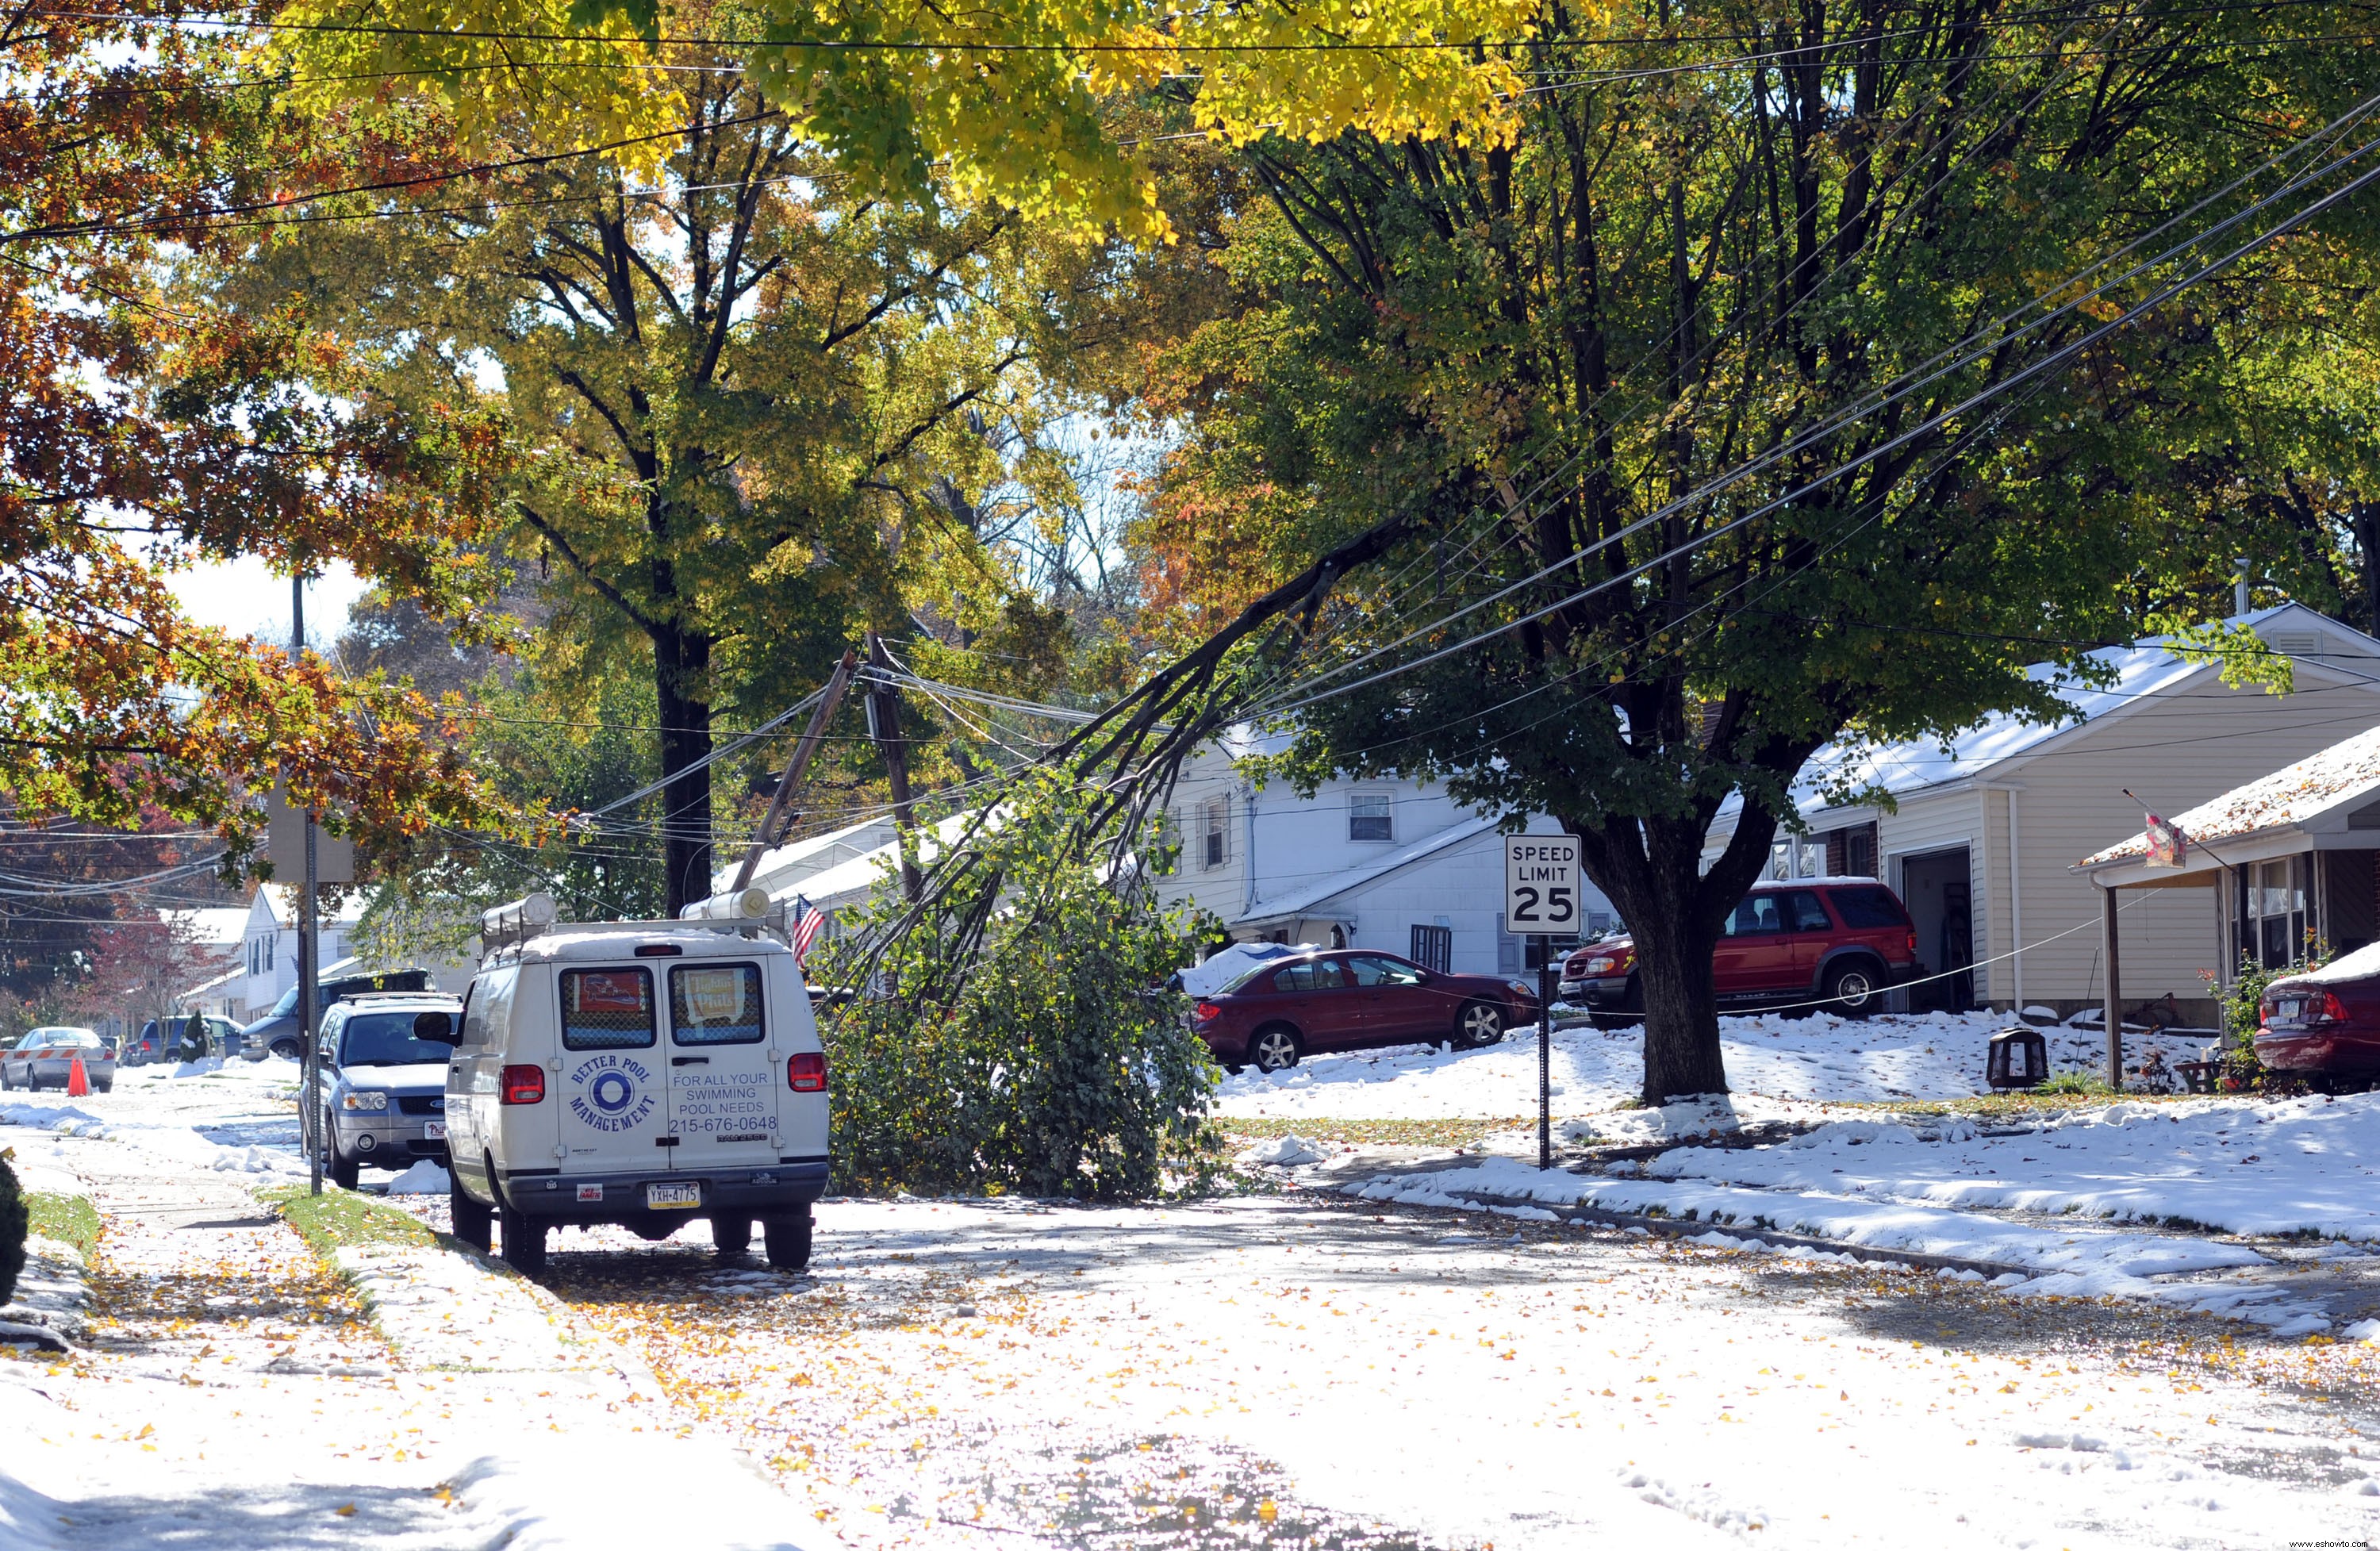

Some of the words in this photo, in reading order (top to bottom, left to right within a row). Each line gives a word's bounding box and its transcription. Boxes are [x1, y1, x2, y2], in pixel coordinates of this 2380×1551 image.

[1513, 847, 1574, 862] SPEED
[1518, 867, 1568, 881] LIMIT
[1514, 886, 1573, 923] 25
[571, 1055, 616, 1085] BETTER
[622, 1058, 650, 1083] POOL
[674, 1076, 701, 1087] FOR
[704, 1075, 727, 1085] ALL
[730, 1073, 767, 1085] YOUR
[686, 1088, 756, 1100] SWIMMING
[570, 1095, 655, 1132] MANAGEMENT
[679, 1104, 716, 1115] POOL
[720, 1101, 764, 1113] NEEDS
[670, 1116, 777, 1133] 215-676-0648
